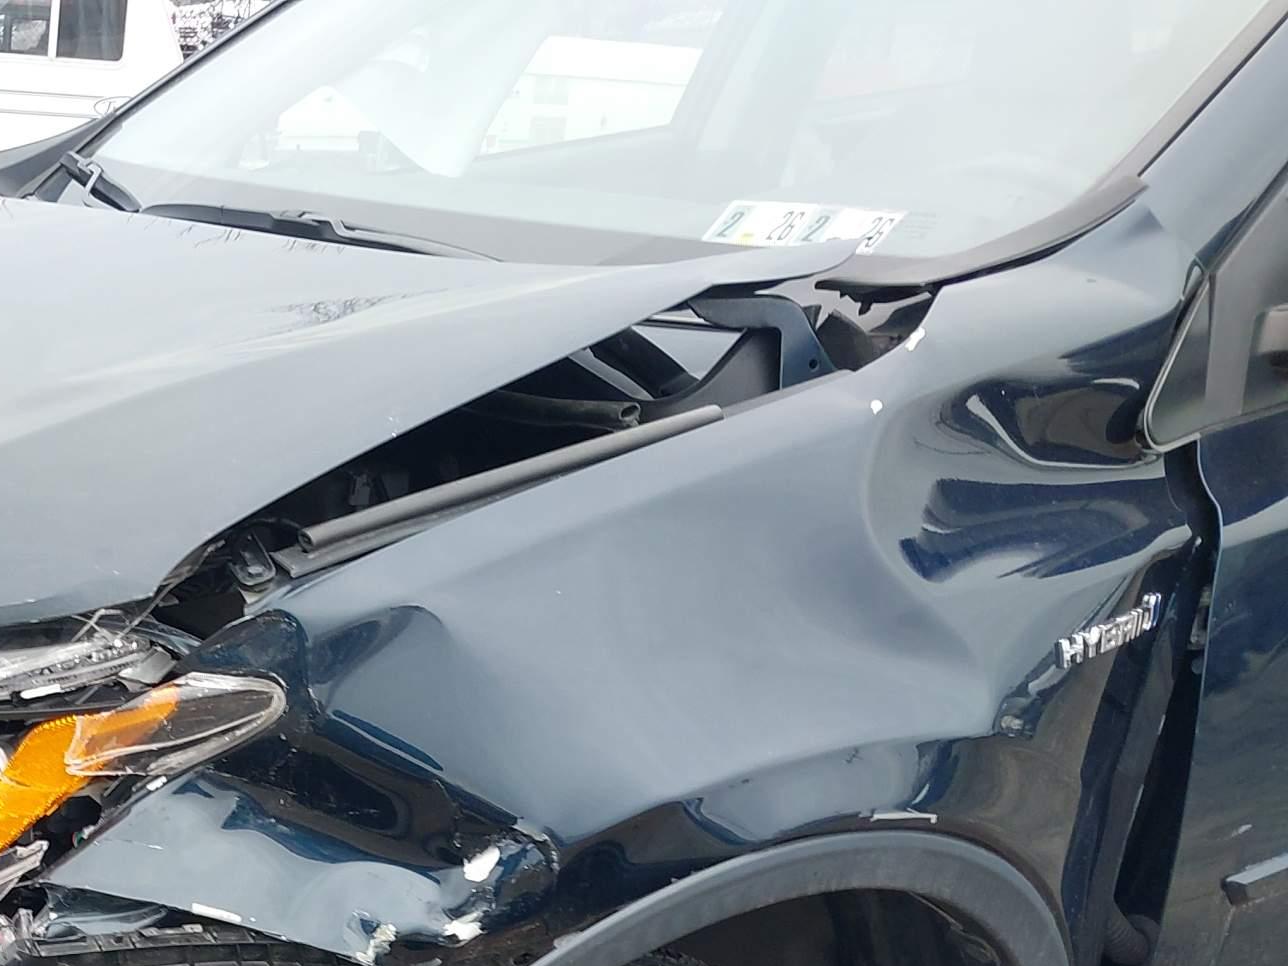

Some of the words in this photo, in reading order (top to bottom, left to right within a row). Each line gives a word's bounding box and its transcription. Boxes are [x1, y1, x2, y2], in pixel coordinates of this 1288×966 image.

[716, 211, 744, 237] 2
[765, 211, 807, 241] 26
[801, 215, 831, 242] 2
